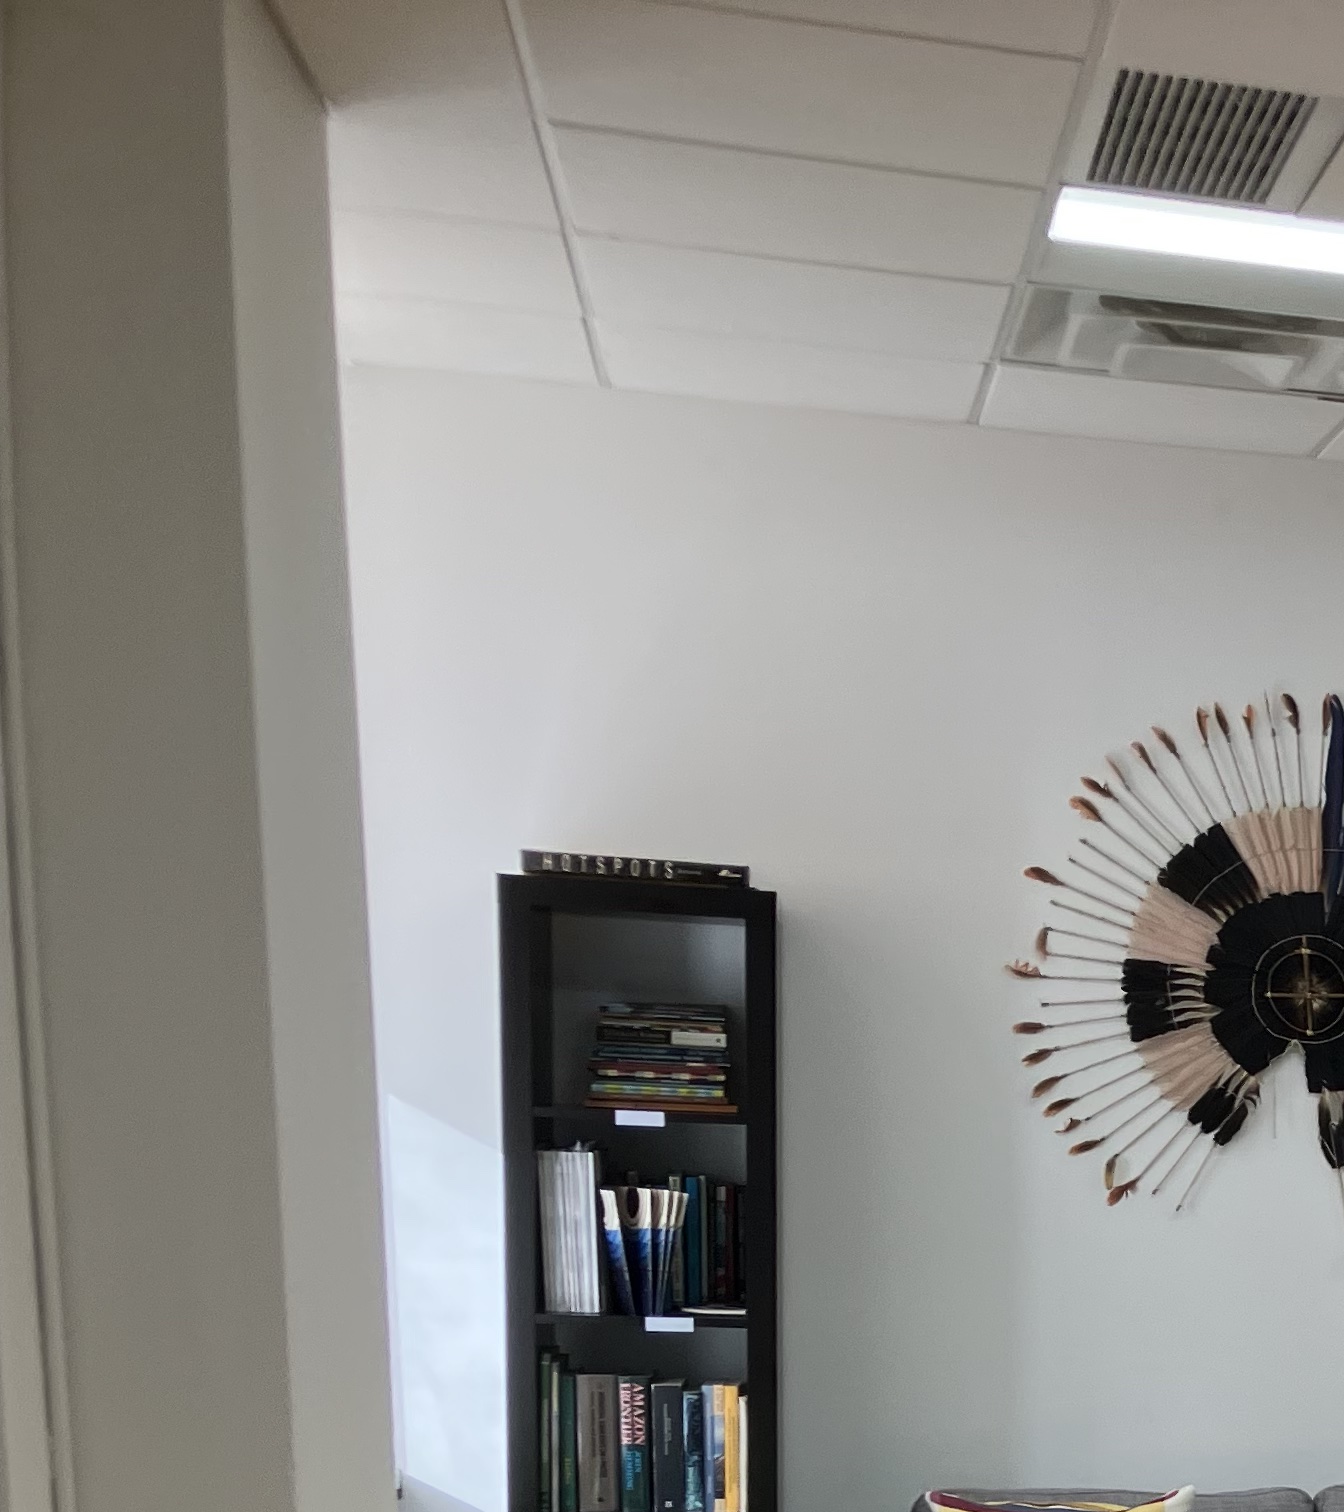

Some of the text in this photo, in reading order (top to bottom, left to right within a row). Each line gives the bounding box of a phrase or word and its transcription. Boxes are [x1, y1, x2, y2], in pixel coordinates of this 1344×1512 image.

[541, 852, 675, 880] HOTSPOTS
[620, 1383, 633, 1446] FRONTIER
[633, 1383, 646, 1446] AMAZON
